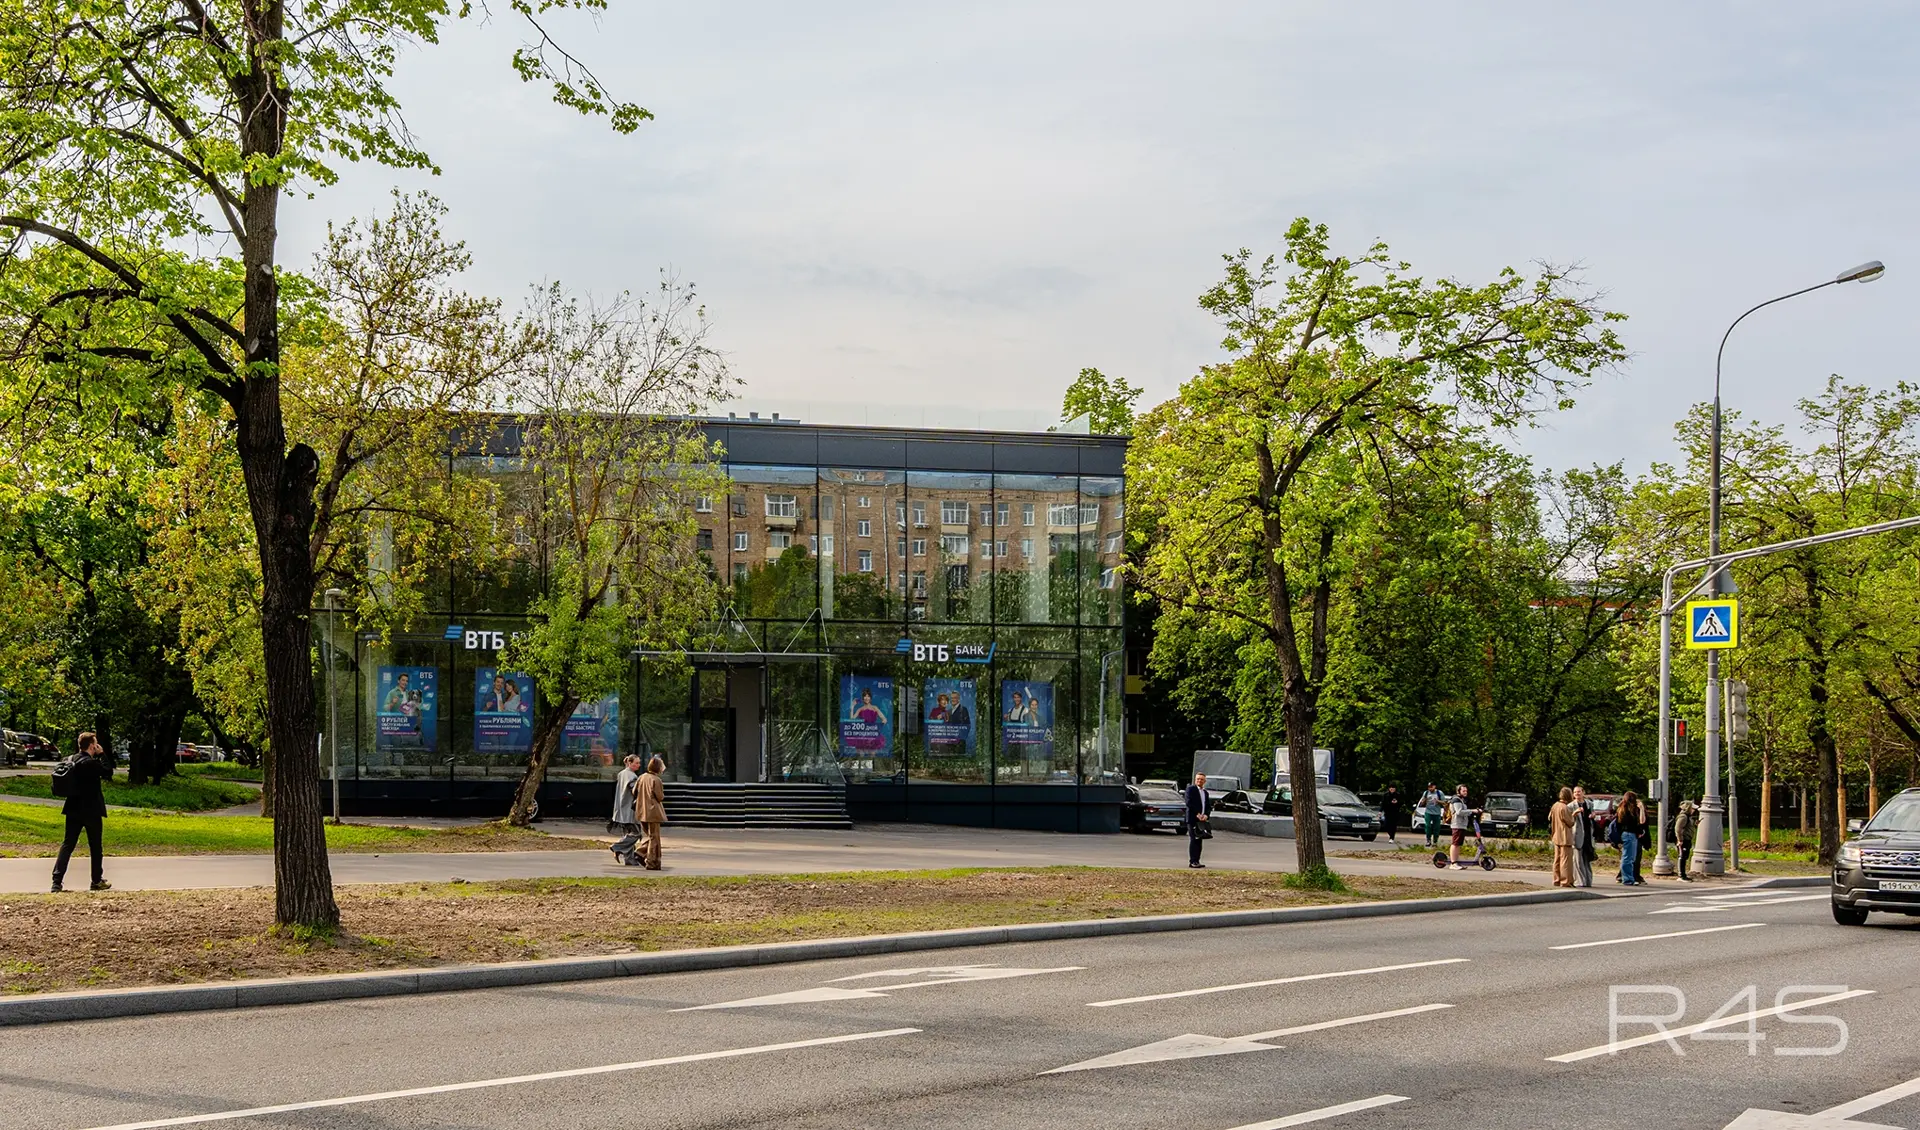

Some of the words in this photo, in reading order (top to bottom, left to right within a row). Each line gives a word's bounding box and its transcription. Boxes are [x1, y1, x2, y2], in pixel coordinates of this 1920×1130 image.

[465, 630, 505, 650] ВТБ
[914, 644, 949, 662] ВТБ
[955, 645, 984, 655] БАНК
[419, 671, 434, 679] ВТБ
